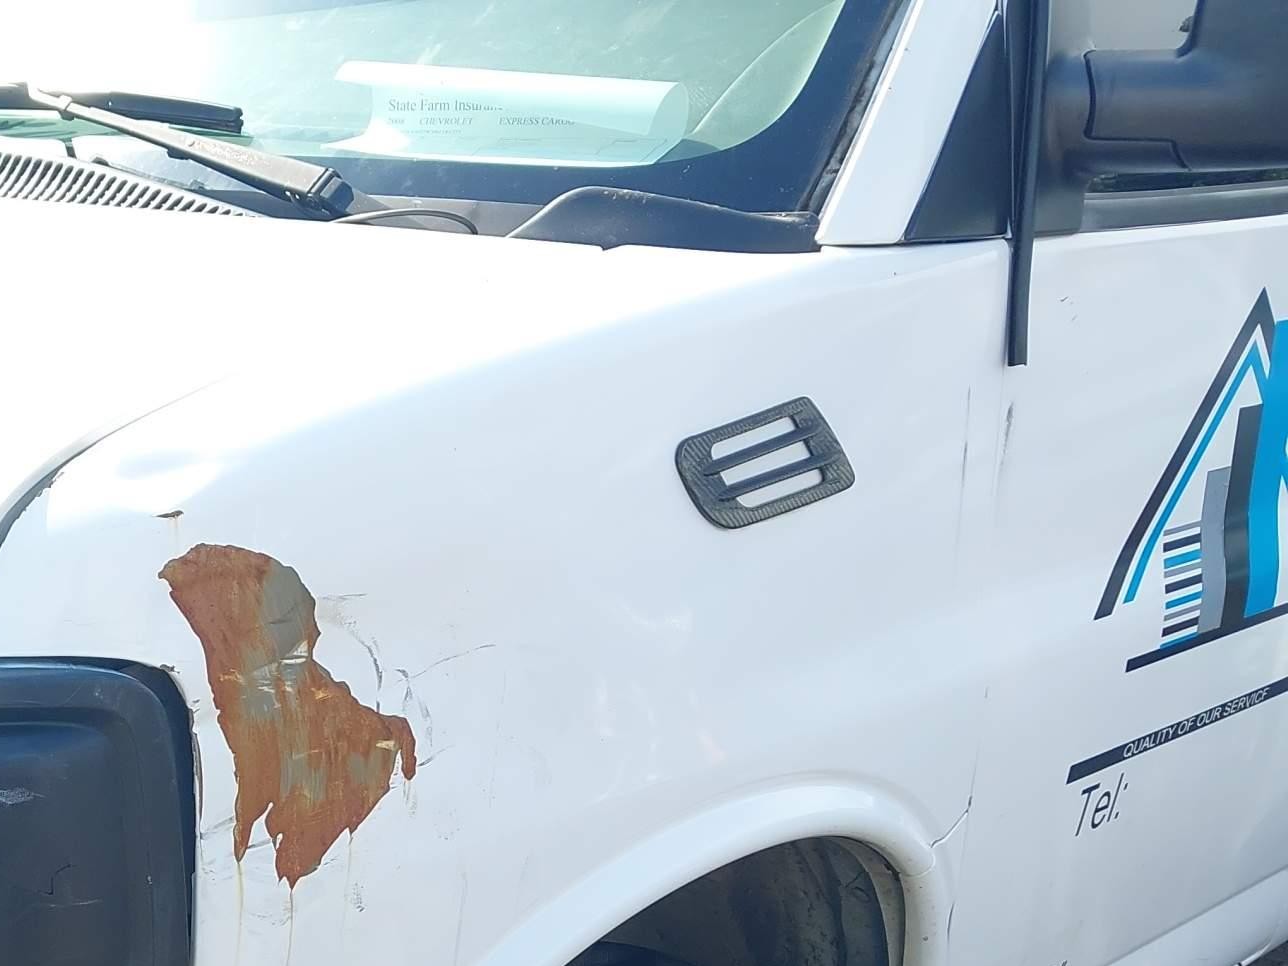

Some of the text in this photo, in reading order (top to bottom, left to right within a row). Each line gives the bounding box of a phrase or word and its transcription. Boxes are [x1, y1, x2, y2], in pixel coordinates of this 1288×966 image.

[388, 99, 417, 112] State
[420, 99, 450, 112] Farm
[418, 116, 473, 125] CHEVROLET
[498, 116, 539, 126] EXPRESS
[1122, 724, 1178, 758] QUALITY
[1177, 716, 1197, 736] OF
[1196, 706, 1223, 728] OUR
[1075, 772, 1129, 837] Tel:
